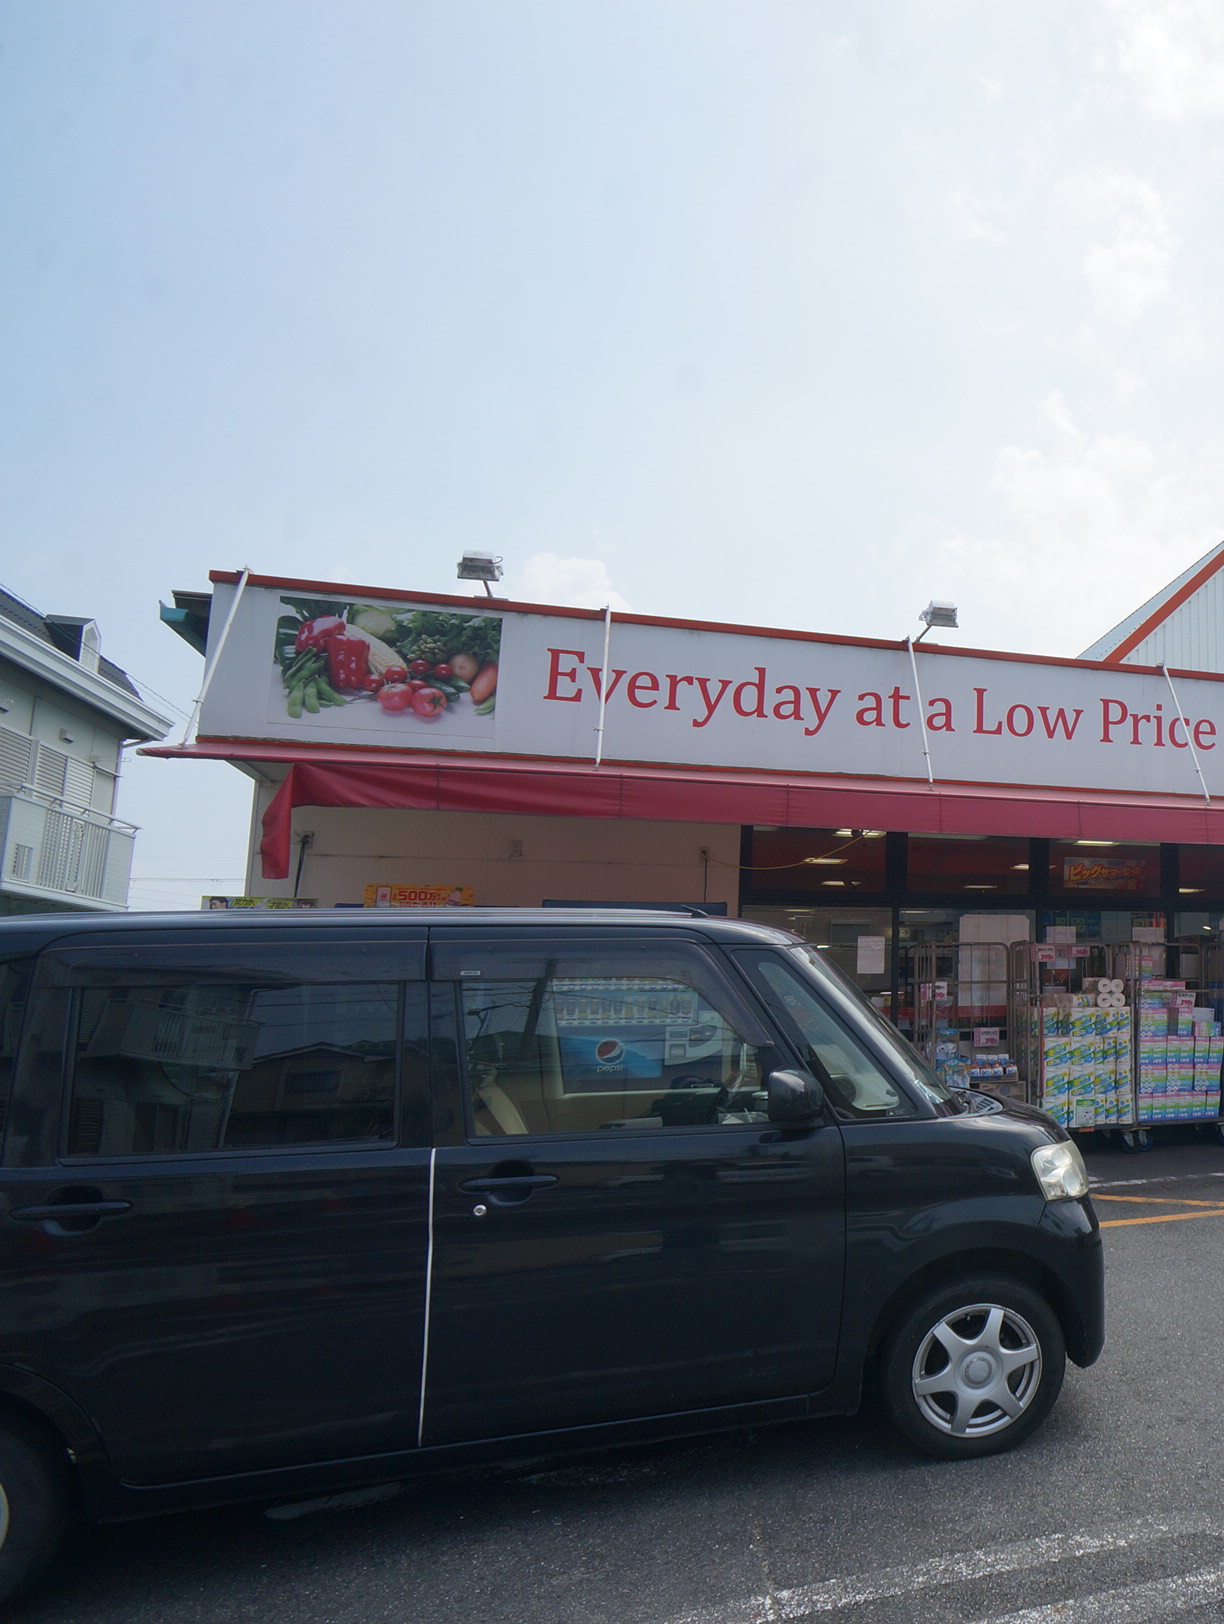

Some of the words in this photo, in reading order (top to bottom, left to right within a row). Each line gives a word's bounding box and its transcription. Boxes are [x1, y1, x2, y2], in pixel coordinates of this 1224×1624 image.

[543, 648, 841, 736] Everyday
[855, 686, 911, 729] at
[926, 697, 955, 732] a
[972, 687, 1084, 740] Low
[1099, 698, 1217, 750] Price
